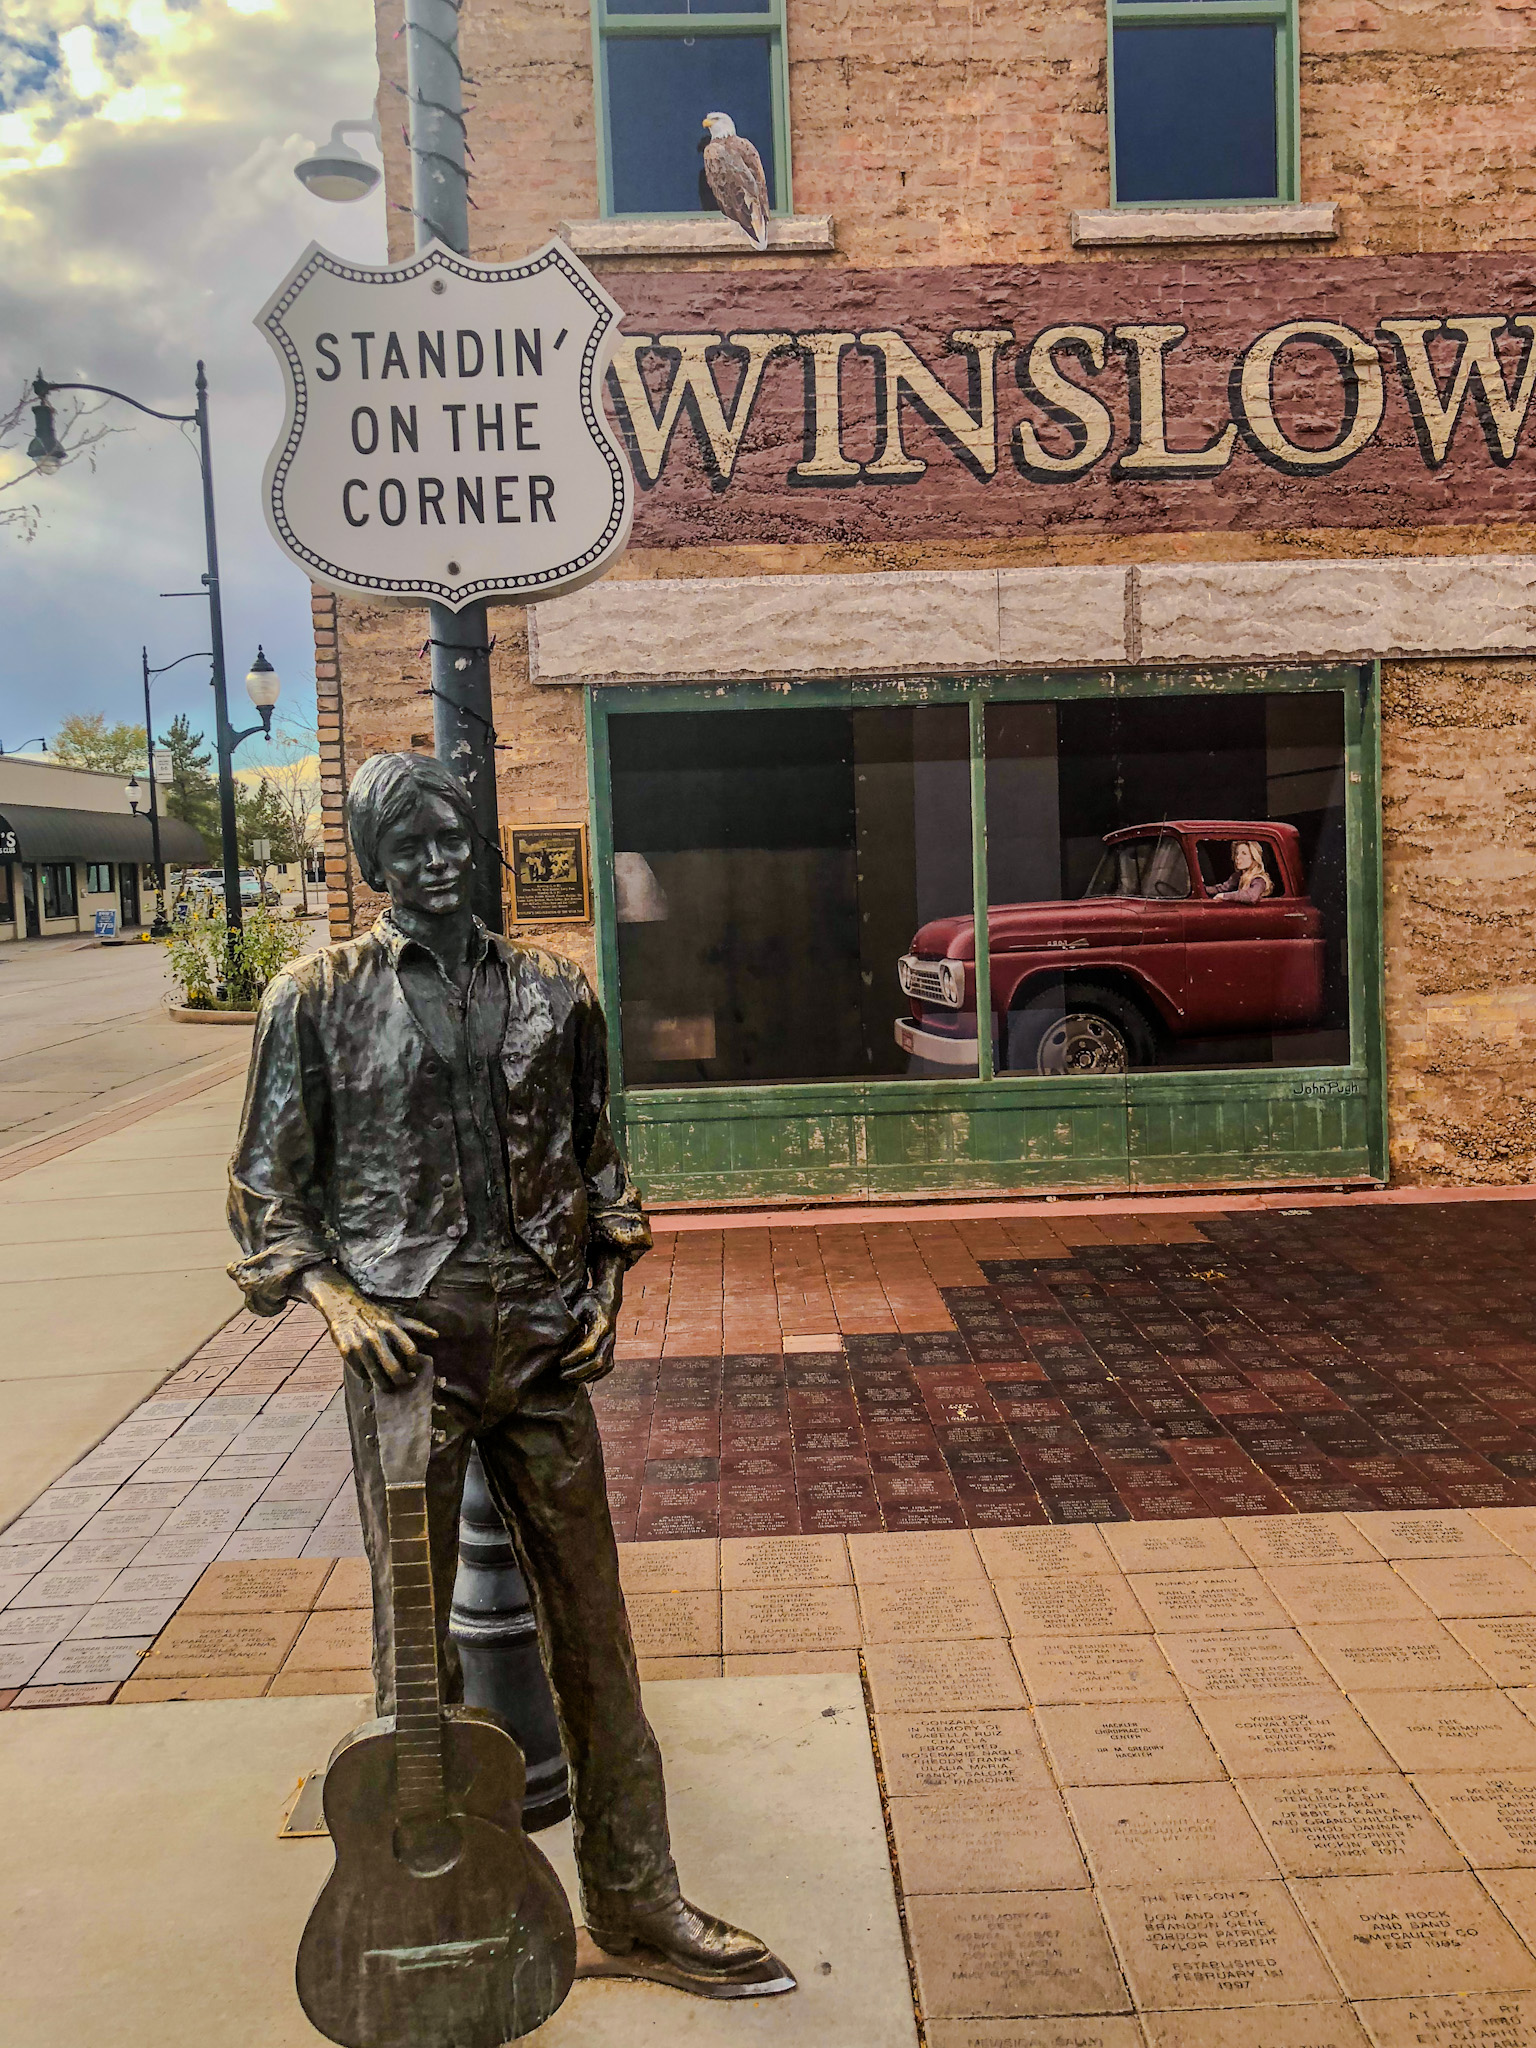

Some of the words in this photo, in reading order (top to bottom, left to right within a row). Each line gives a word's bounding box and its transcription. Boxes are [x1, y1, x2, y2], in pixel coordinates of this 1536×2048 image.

[316, 328, 568, 381] STANDIN'
[606, 314, 1536, 493] WINSLOW
[351, 406, 419, 454] ON
[442, 403, 540, 452] THE
[342, 476, 556, 527] CORNER
[1294, 1082, 1327, 1095] John
[1329, 1081, 1359, 1096] Pugh
[1235, 1720, 1330, 1728] CONVALESCENT
[1298, 1801, 1374, 1809] NORGAARD
[1282, 1810, 1329, 1818] DEBBIE
[1272, 1819, 1298, 1827] AND
[1305, 1814, 1422, 1825] GRANDCHILDREN
[1307, 1831, 1405, 1840] CHRISTOPHER
[1140, 1895, 1166, 1903] THE
[1144, 1913, 1176, 1921] DON
[1223, 1910, 1258, 1918] JOEY
[1360, 1913, 1399, 1921] DYNA
[1405, 1911, 1450, 1919] ROCK
[1145, 1922, 1218, 1931] BRANDON
[1226, 1919, 1267, 1927] GENE
[1216, 1929, 1277, 1937] PATRICK
[1369, 1931, 1447, 1940] McCAULEY
[1153, 1942, 1208, 1951] TAYLOR
[1217, 1938, 1277, 1948] ROBERT
[1173, 1959, 1277, 1970] ESTABLISHED
[1172, 1970, 1255, 1981] FEBRUARY
[1218, 1982, 1249, 1990] 1997
